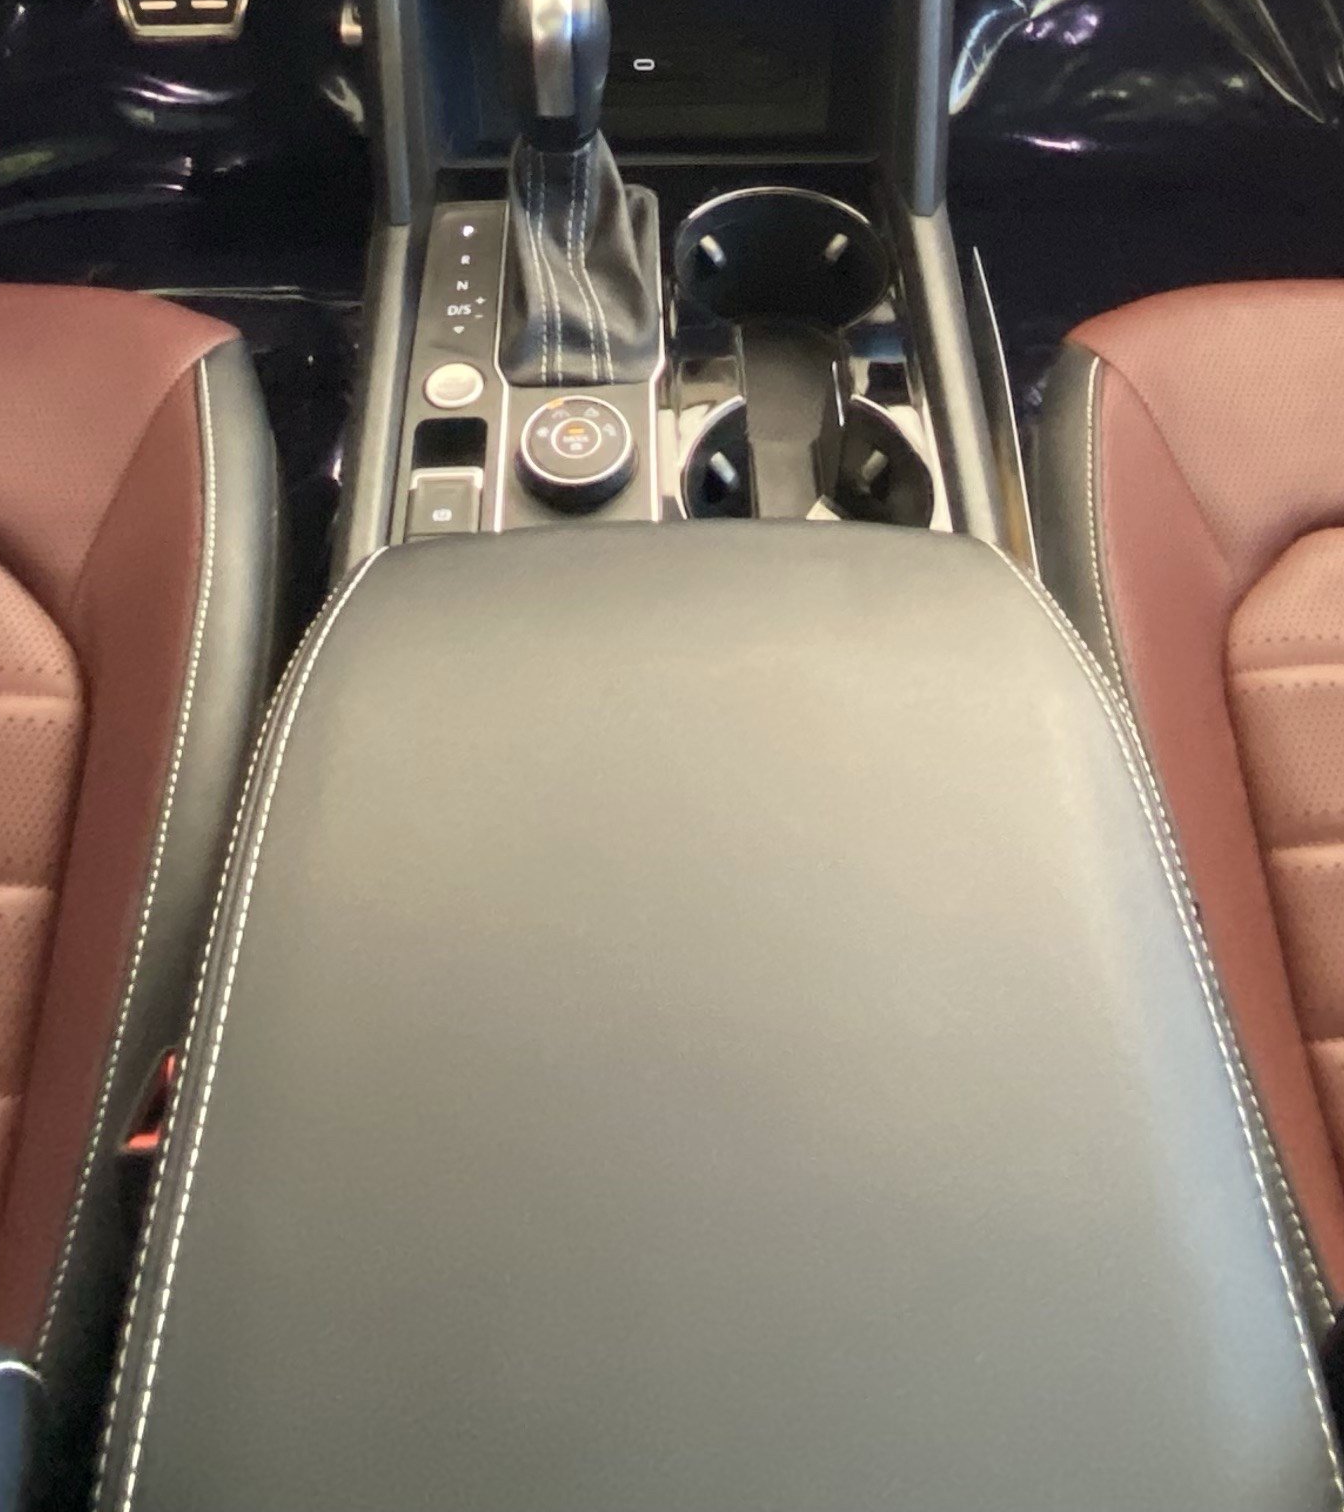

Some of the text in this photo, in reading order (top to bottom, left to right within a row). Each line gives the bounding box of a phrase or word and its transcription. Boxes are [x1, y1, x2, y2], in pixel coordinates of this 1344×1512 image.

[462, 225, 474, 237] P
[460, 255, 471, 266] R
[456, 280, 469, 291] N
[447, 304, 472, 316] D/S
